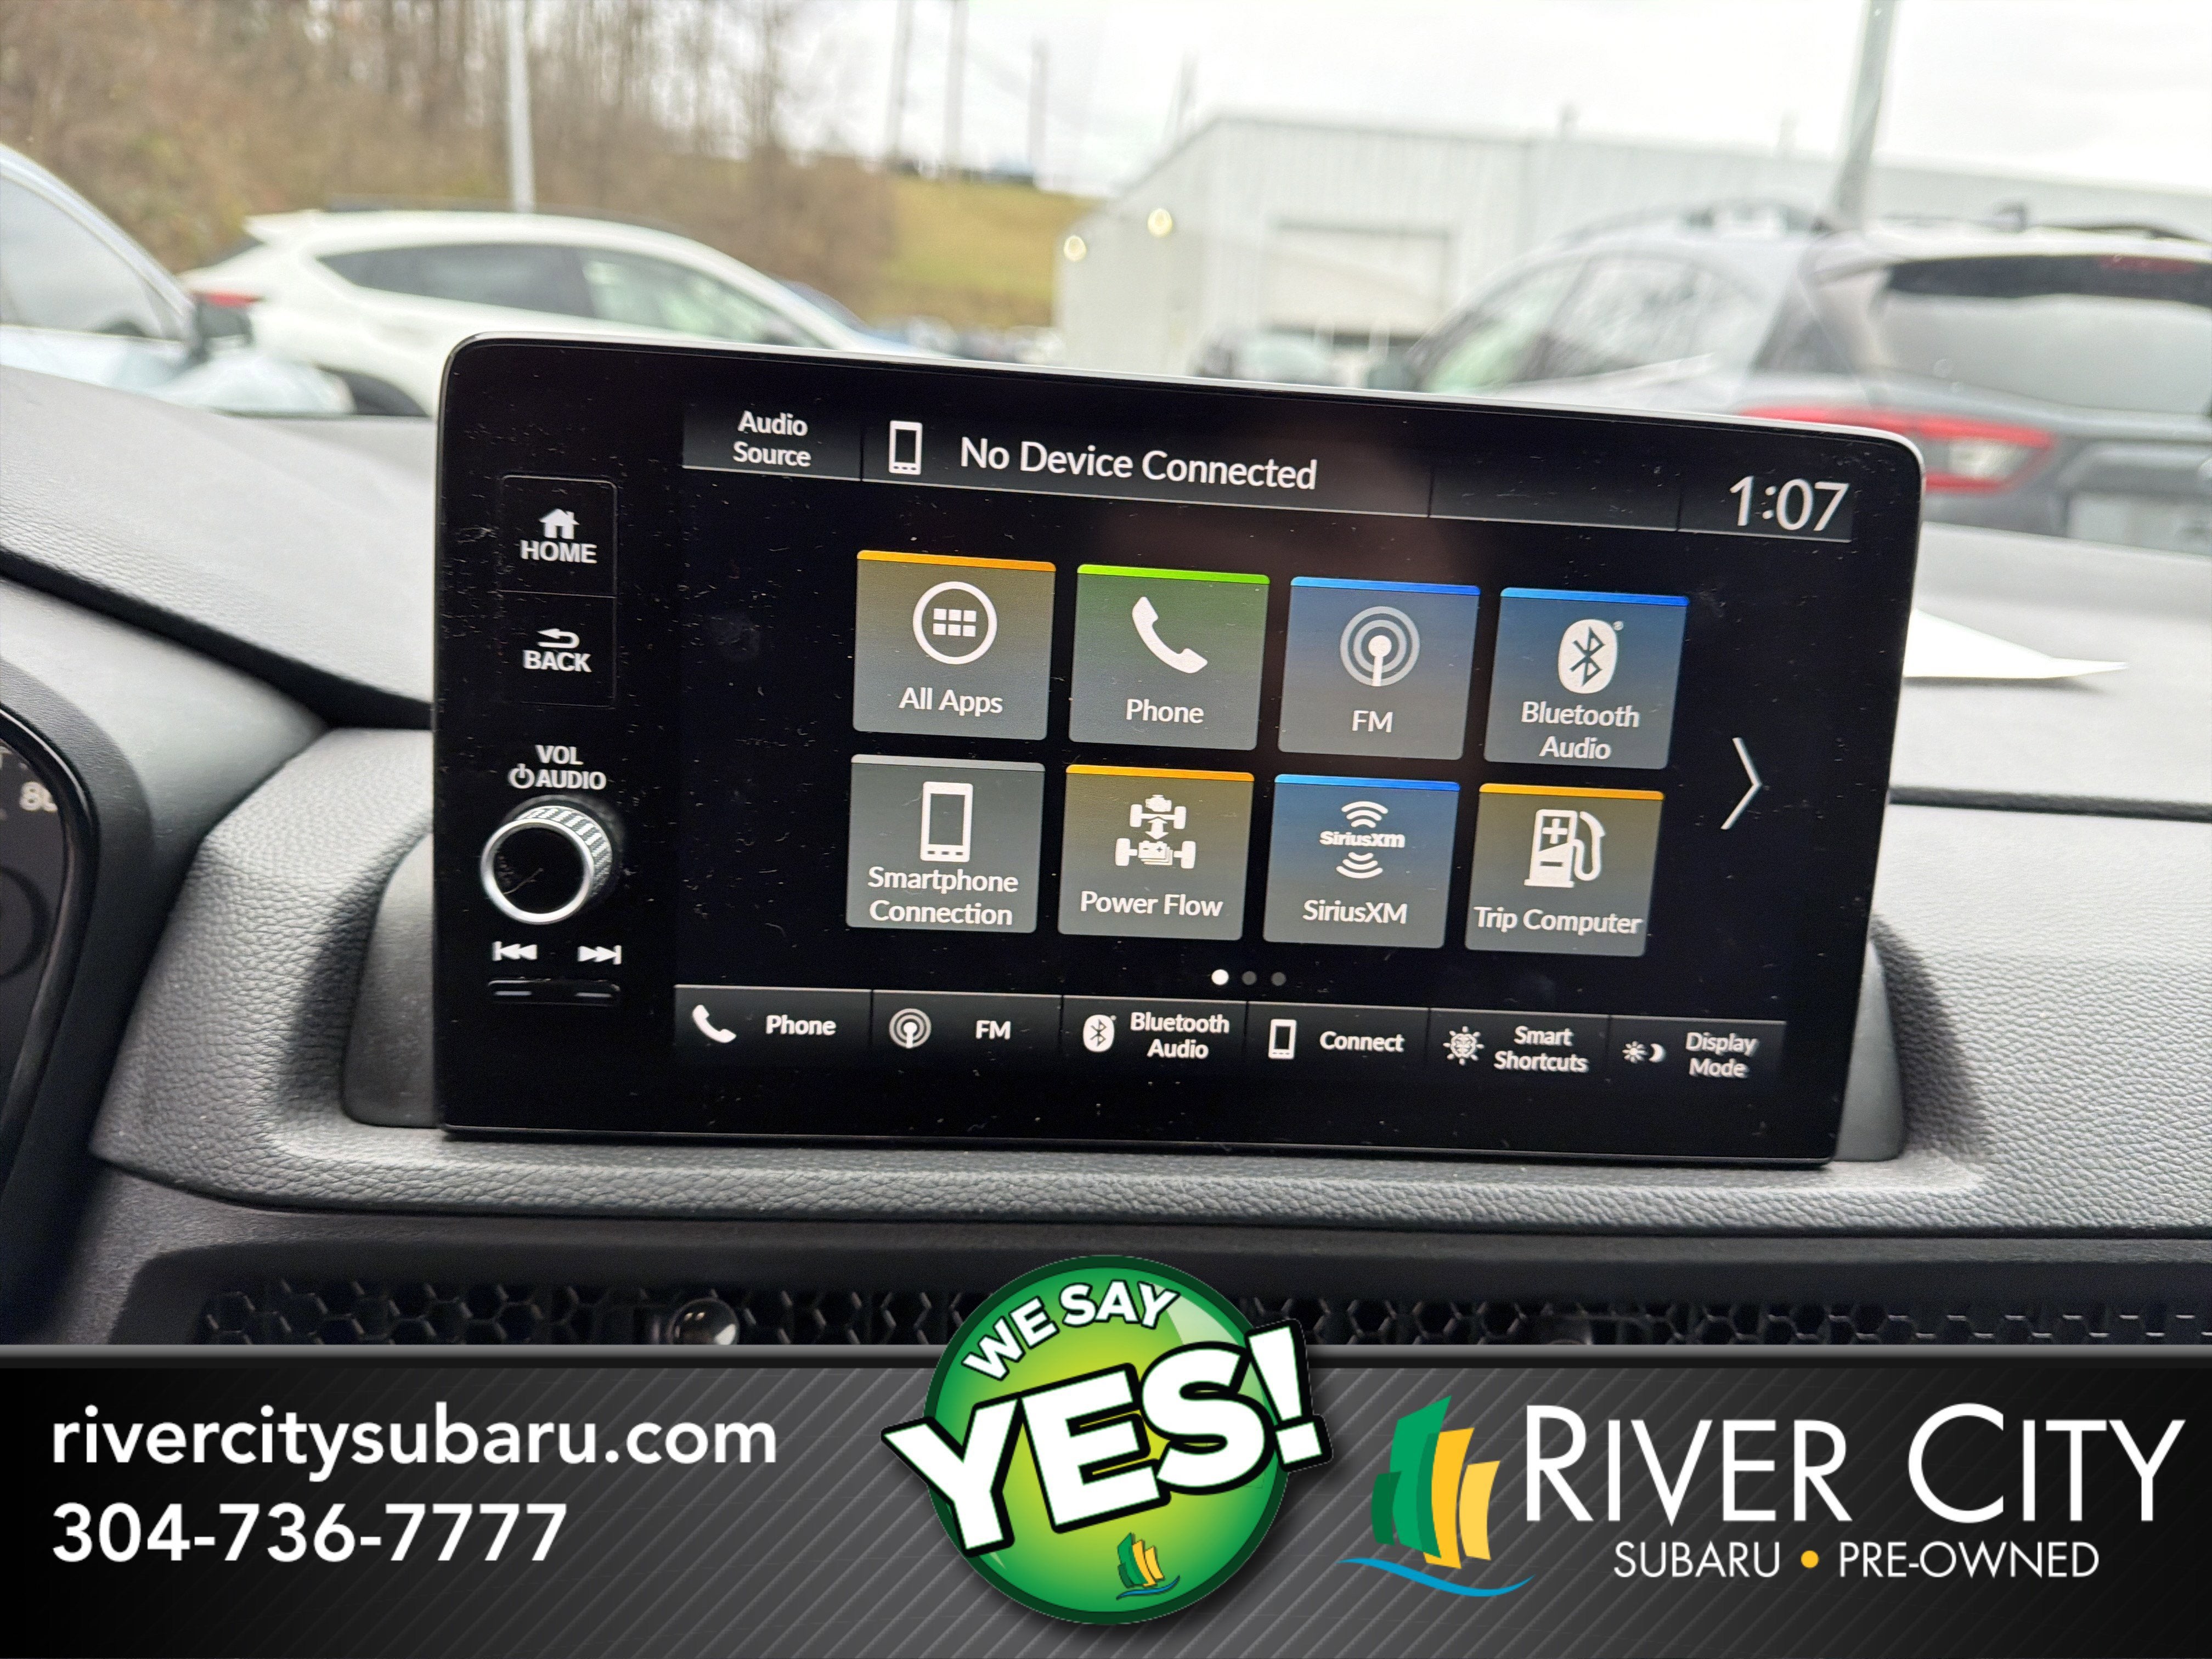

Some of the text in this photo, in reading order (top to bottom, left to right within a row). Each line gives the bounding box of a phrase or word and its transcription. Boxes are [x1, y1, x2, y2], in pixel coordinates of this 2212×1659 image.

[737, 410, 809, 437] Audio
[732, 441, 812, 467] Source
[960, 436, 1318, 490] No Device Connected
[1730, 475, 1850, 532] 1:07
[521, 539, 597, 564] HOME
[523, 649, 592, 673] BACK
[898, 686, 1003, 718] All Apps
[1125, 698, 1205, 724] Phone
[1520, 700, 1640, 728] Bluetooth
[1351, 709, 1393, 733] FM
[535, 744, 584, 766] VOL
[1538, 735, 1612, 760] Audio
[536, 768, 607, 791] AUDIO
[867, 866, 1019, 895] Smartphone
[869, 899, 1013, 926] Connection
[1080, 890, 1224, 917] Power Flow
[1302, 899, 1408, 925] SiriusXM
[1472, 906, 1644, 936] Trip Computer
[765, 1014, 837, 1036] Phone
[975, 1019, 1012, 1040] FM
[1130, 1011, 1231, 1034] Bluetooth
[1319, 1030, 1406, 1053] Connect
[1513, 1025, 1573, 1047] Smart
[1685, 1031, 1758, 1057] Display
[1146, 1038, 1210, 1060] Audio
[1493, 1049, 1589, 1073] Shortcuts
[1689, 1057, 1748, 1079] Mode
